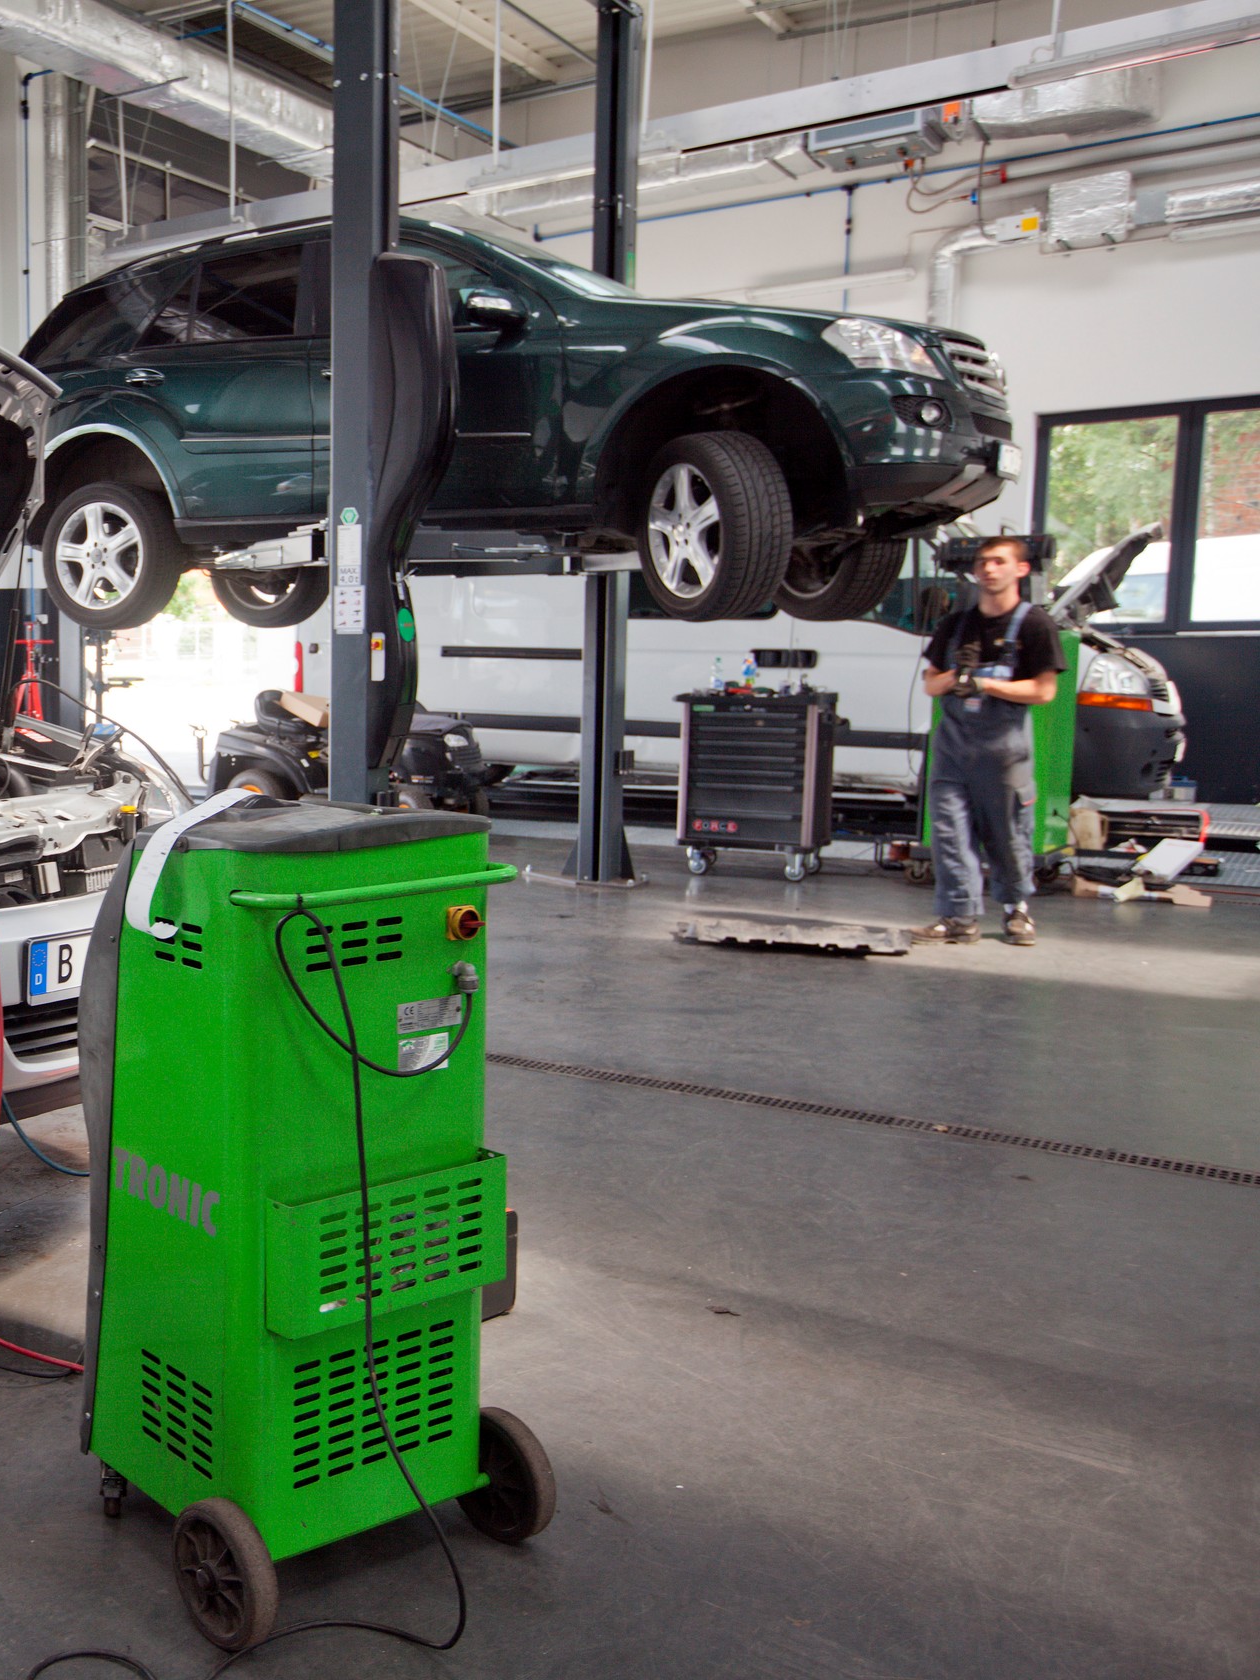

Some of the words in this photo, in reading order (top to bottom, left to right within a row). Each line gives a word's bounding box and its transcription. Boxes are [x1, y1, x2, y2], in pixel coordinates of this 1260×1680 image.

[35, 973, 43, 985] D
[58, 944, 73, 984] B
[113, 1145, 220, 1237] TRONIC
